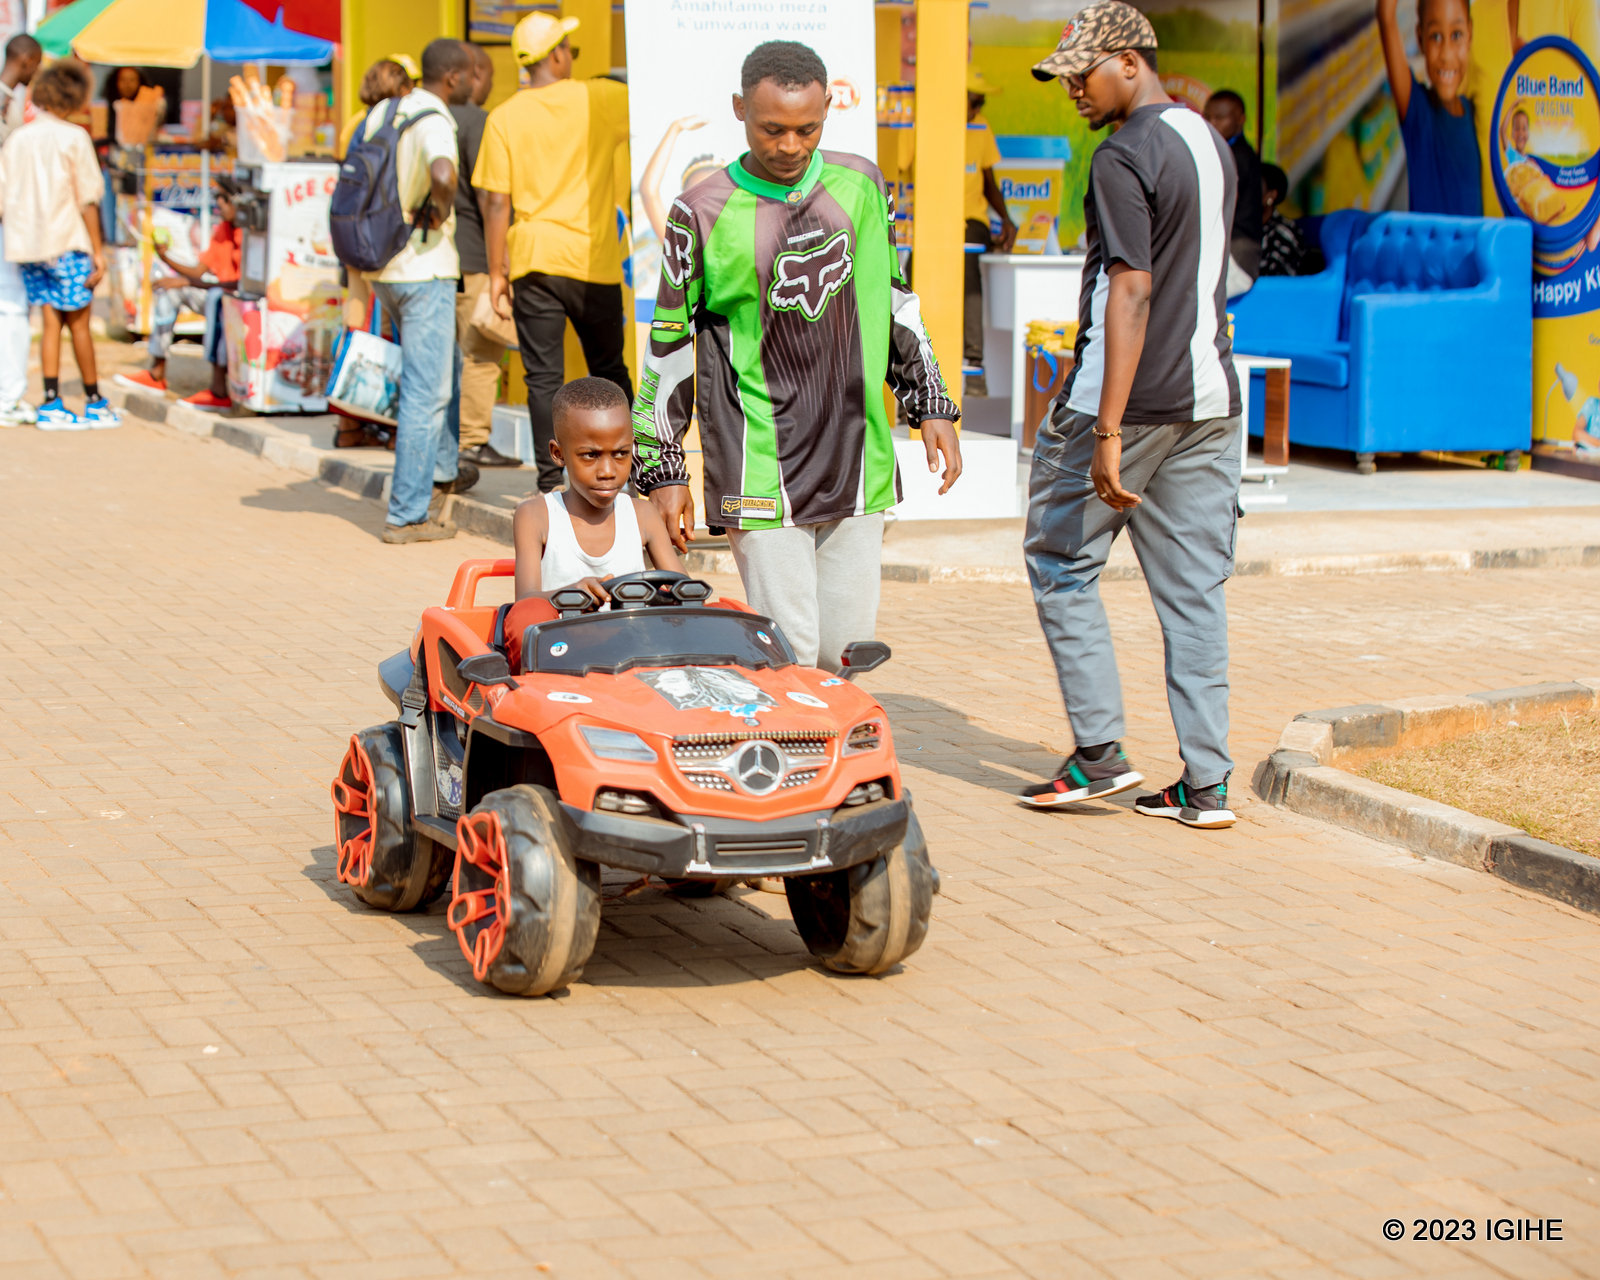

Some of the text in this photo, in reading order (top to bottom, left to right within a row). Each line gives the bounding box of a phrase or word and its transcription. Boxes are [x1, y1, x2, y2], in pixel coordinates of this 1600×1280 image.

[670, 0, 827, 13] Amahitamo meza
[776, 20, 827, 31] wawe
[1516, 75, 1584, 98] Blue Band
[1535, 100, 1575, 118] ORIGINAL
[285, 178, 315, 206] ICE
[1002, 178, 1050, 200] Band
[1533, 280, 1582, 308] Happy
[651, 320, 685, 331] SFX
